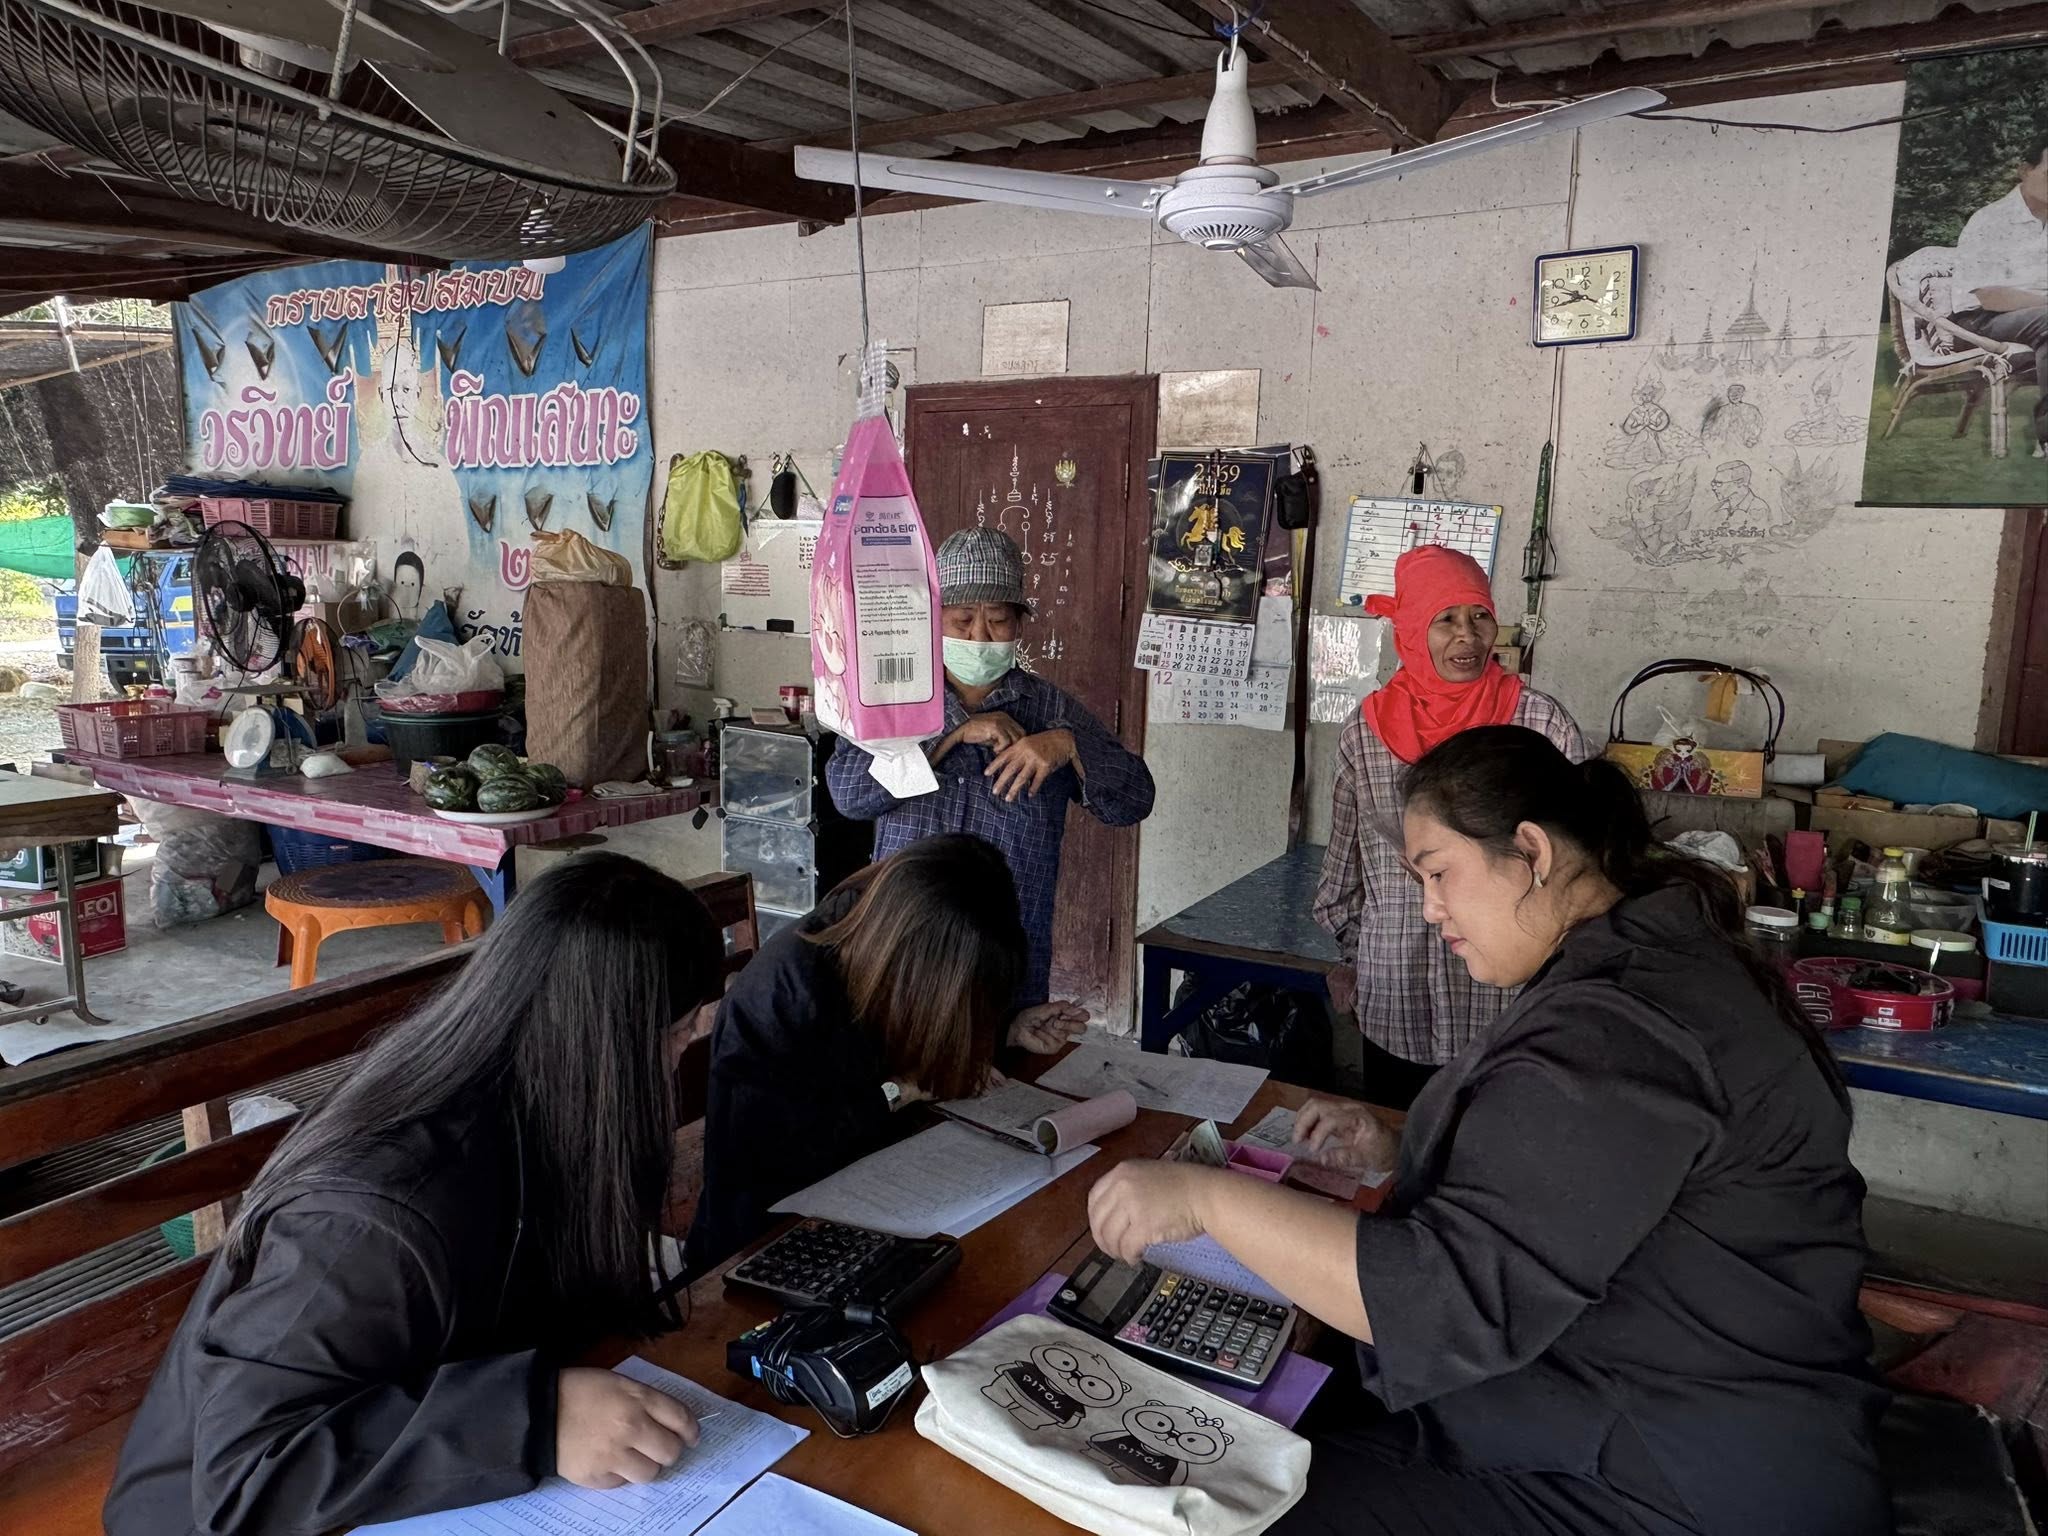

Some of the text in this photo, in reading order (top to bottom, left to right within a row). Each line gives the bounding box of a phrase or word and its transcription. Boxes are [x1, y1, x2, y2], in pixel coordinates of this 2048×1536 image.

[200, 366, 353, 470] วรวิทย์
[1154, 670, 1173, 685] 12
[1022, 1374, 1061, 1409] PITON
